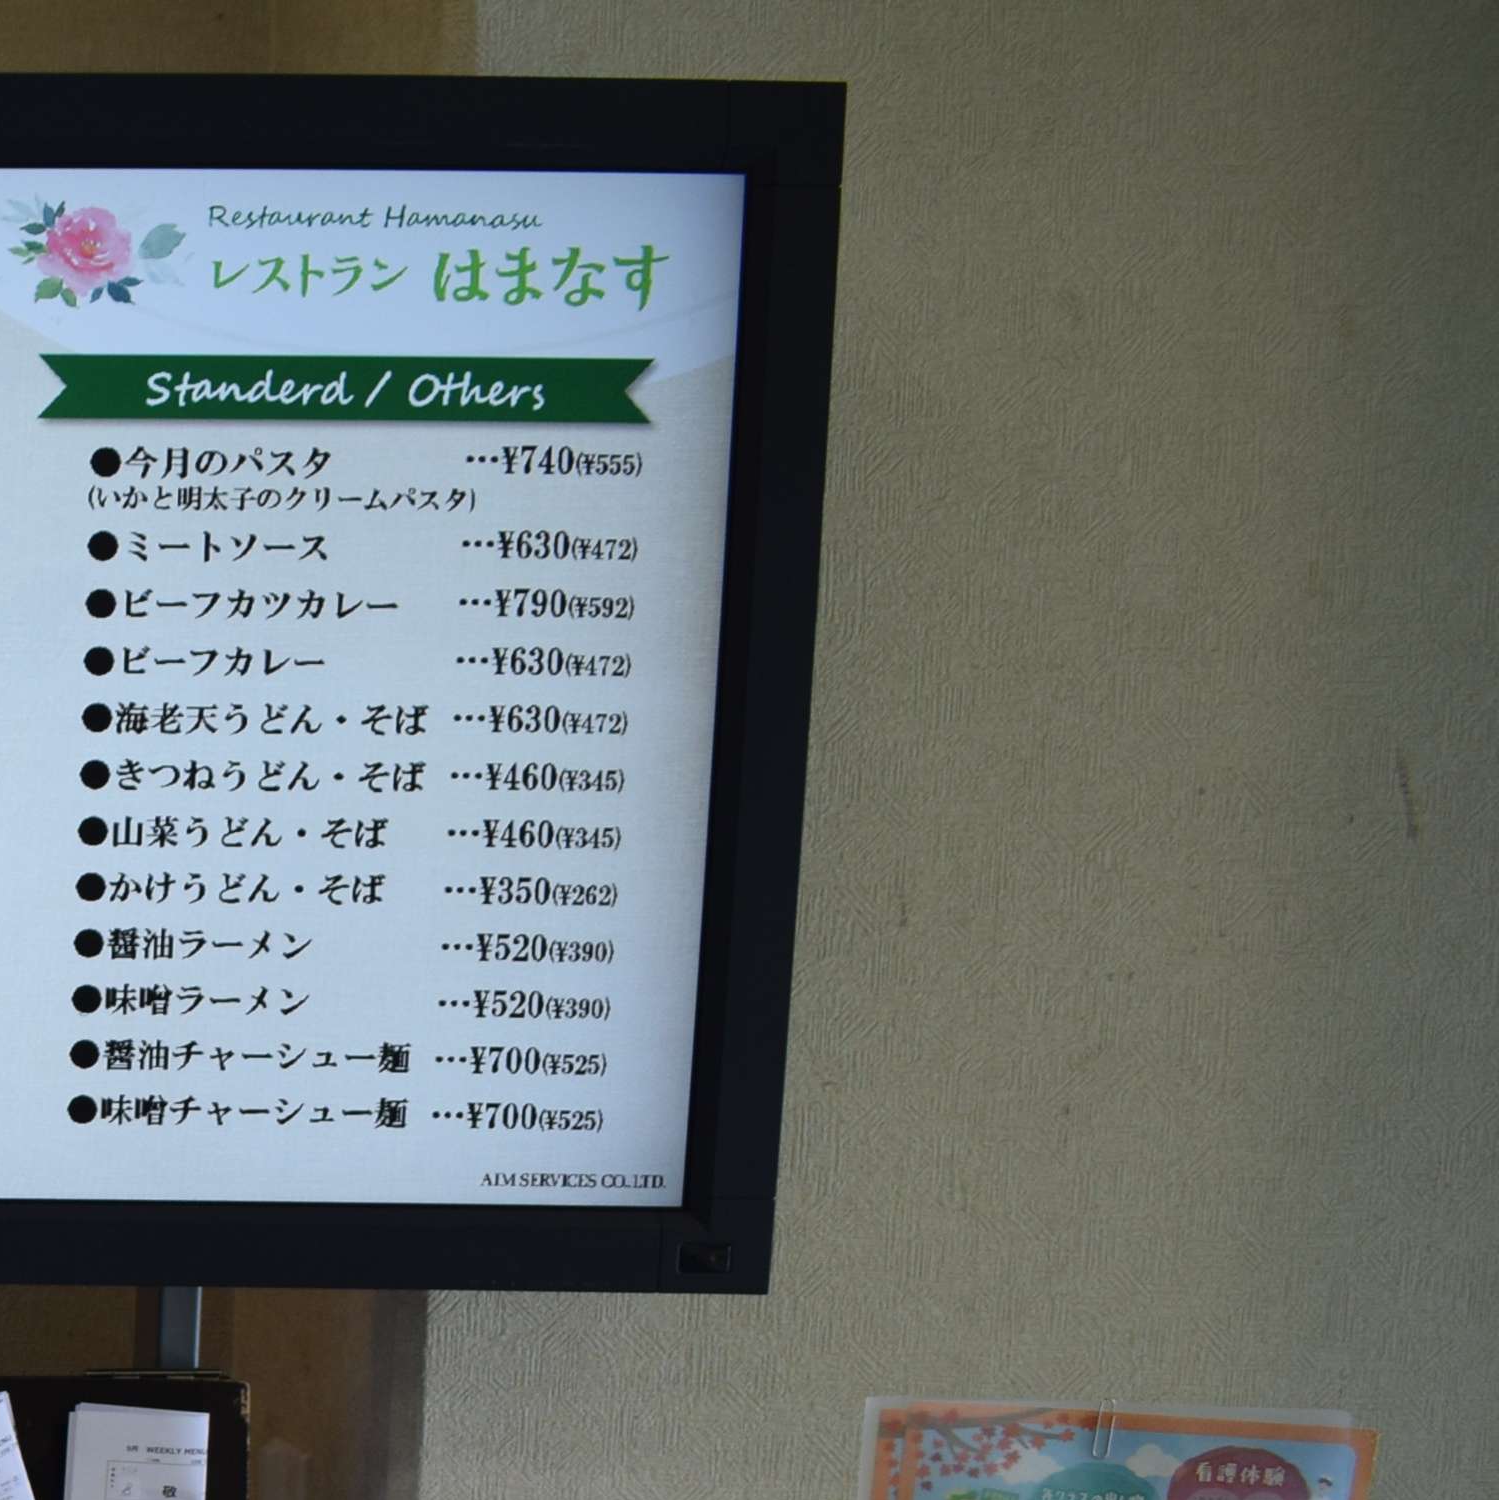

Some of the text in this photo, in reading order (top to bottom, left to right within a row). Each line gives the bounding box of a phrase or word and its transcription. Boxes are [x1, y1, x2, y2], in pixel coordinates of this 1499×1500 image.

[207, 204, 543, 230] Restaurant Hamanasu
[210, 243, 671, 312] レストラン はまなす
[146, 371, 547, 411] Standerd Others
[125, 446, 332, 478] 今月のパスタ
[87, 486, 477, 512] (いかと明太子のクリームパスタ)
[127, 531, 329, 562] ミートソース
[123, 588, 400, 619] ビーフカツカレー
[121, 645, 326, 676] ビーフカレー
[115, 702, 430, 736] 海老天うどん・そば
[115, 759, 426, 792] きつねうどん・そば
[111, 816, 389, 849] 山菜うどん・そば
[109, 872, 386, 905] かけうどん・そば
[107, 928, 313, 961] 醤油ラーメン
[104, 984, 310, 1017] 味噌ラーメン
[100, 1094, 410, 1131] 味噌チャーシュー麺
[480, 1172, 597, 1190] AIM SERVICES
